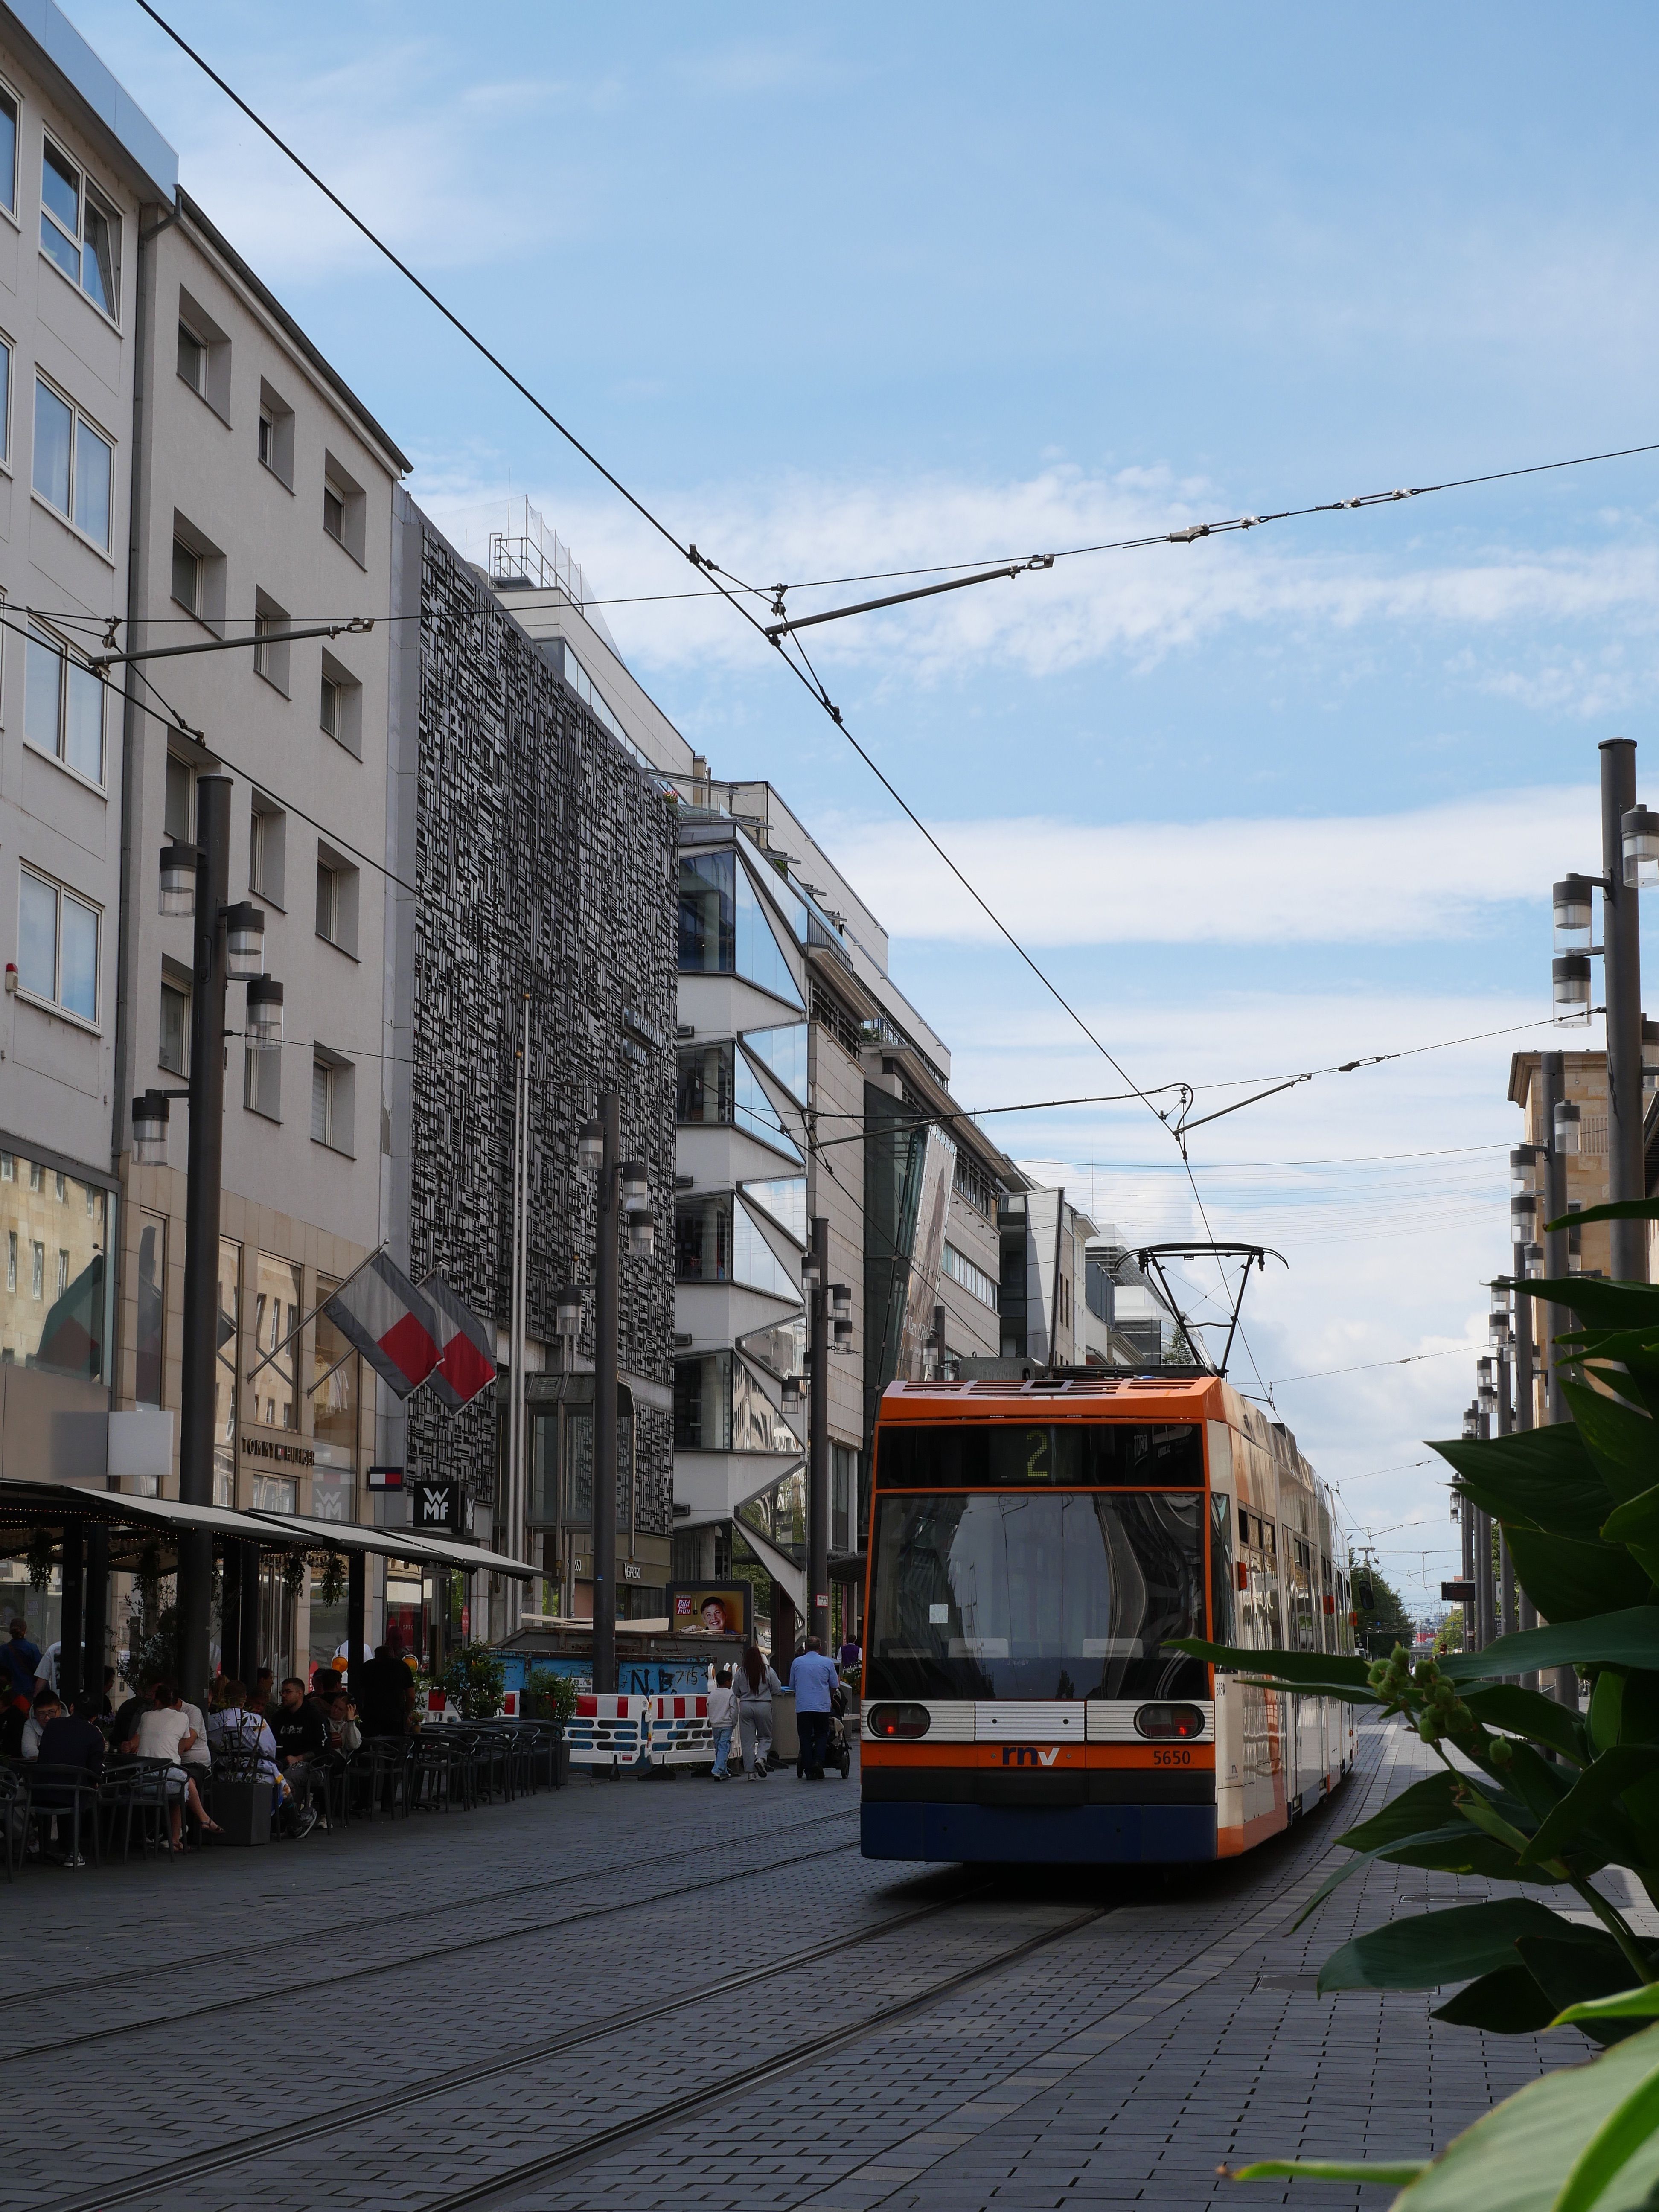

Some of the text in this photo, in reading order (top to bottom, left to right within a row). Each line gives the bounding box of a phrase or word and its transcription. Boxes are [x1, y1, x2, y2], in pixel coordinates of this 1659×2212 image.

[633, 1042, 647, 1067] HAUS
[242, 1437, 315, 1466] TOMMY HILFIGER
[1027, 1430, 1048, 1476] 2
[423, 1487, 449, 1520] WMF
[623, 1563, 641, 1580] NESPRESSO
[1002, 1746, 1060, 1766] rnv
[1153, 1751, 1191, 1765] 5650
